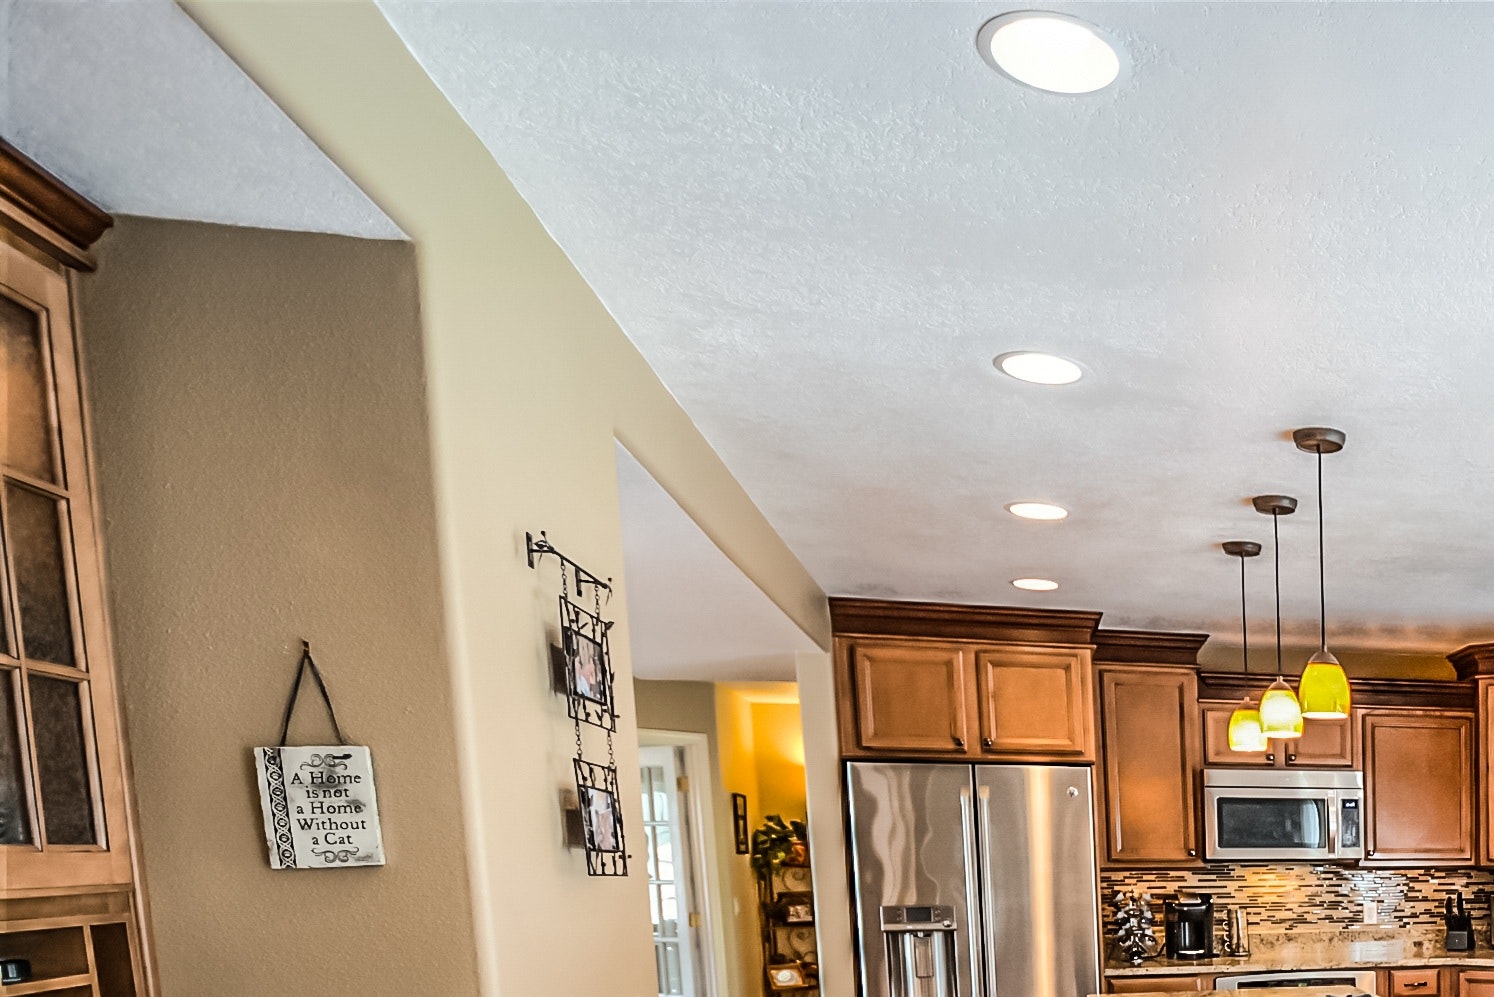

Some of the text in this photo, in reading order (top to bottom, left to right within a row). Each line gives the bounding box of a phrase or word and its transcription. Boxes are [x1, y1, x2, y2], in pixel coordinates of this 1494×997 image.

[291, 771, 361, 784] A Home
[306, 786, 349, 798] is not
[296, 801, 363, 814] a Home
[296, 818, 366, 830] Without
[312, 832, 353, 845] a Cat
